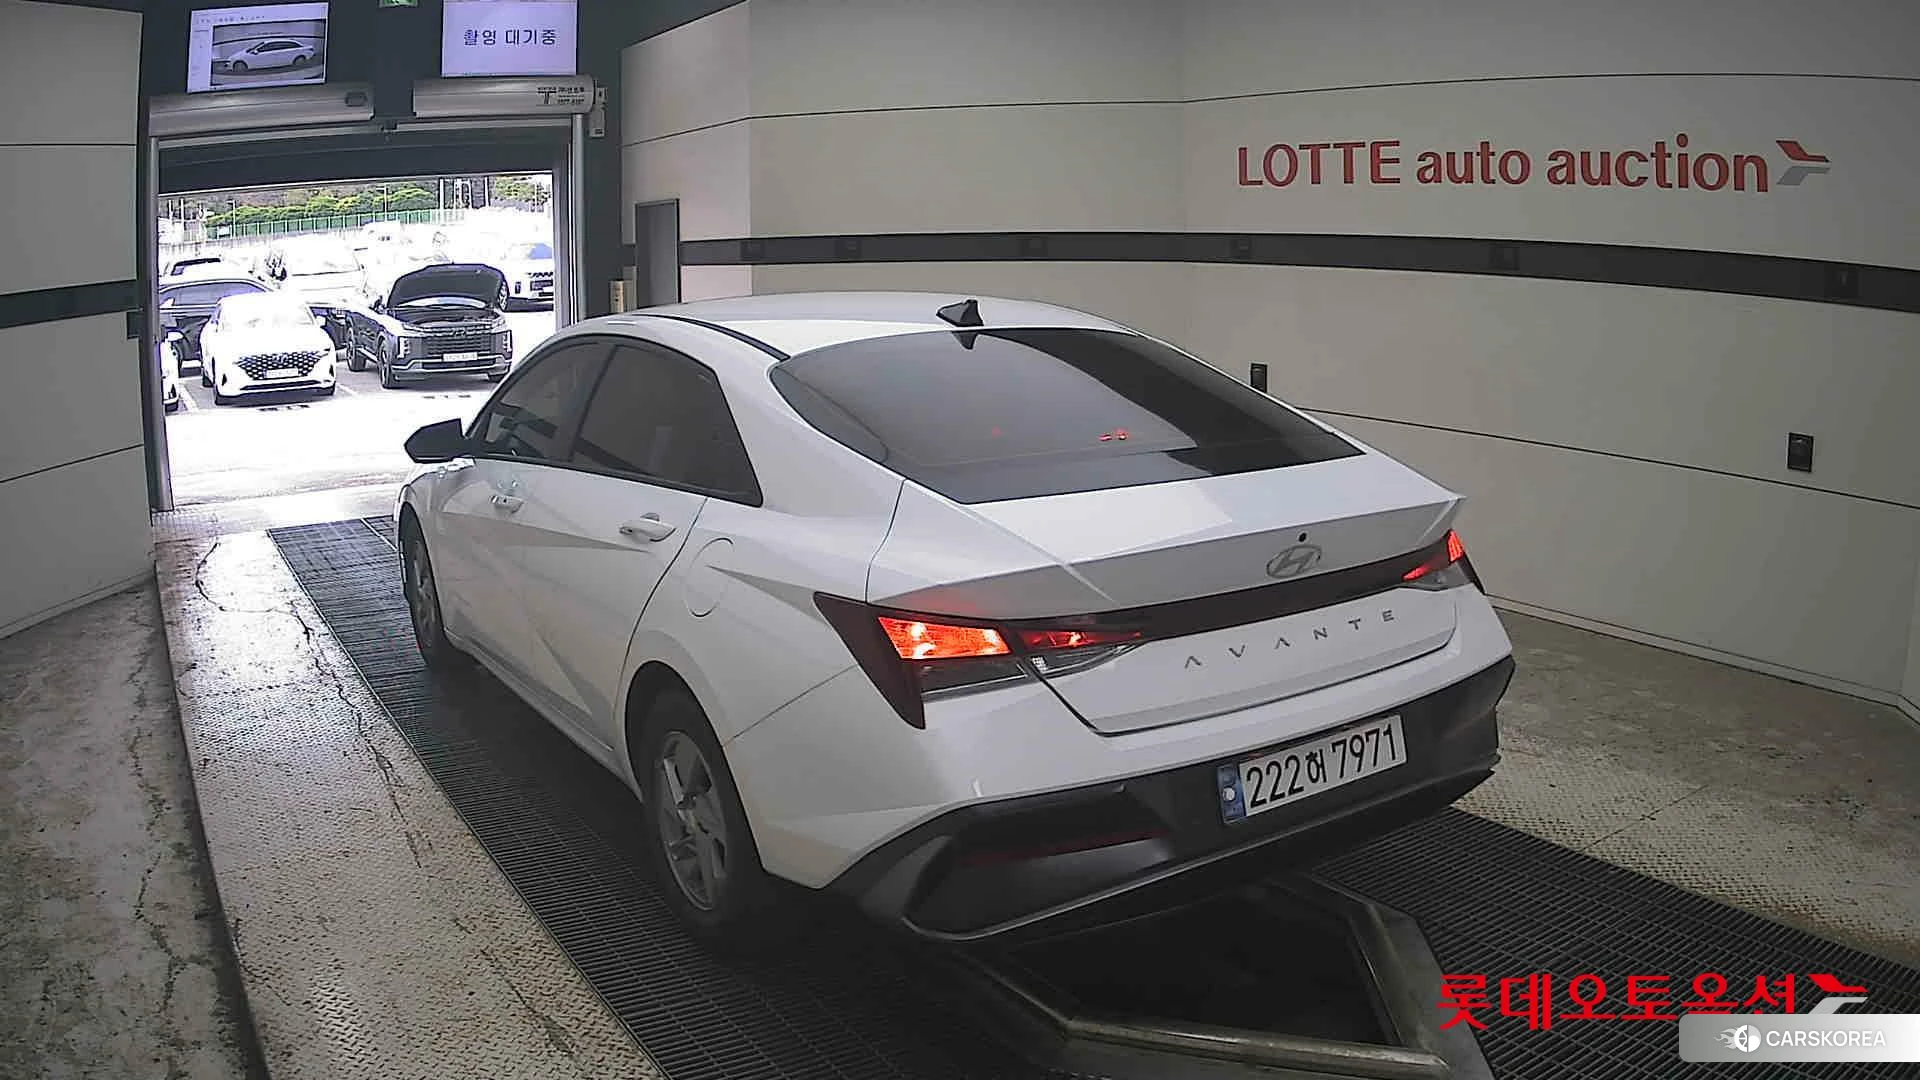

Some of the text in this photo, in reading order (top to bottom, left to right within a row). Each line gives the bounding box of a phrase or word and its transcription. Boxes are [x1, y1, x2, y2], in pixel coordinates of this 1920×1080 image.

[505, 29, 556, 46] 대기중
[1238, 133, 1768, 192] LOTTE auto auction
[1184, 609, 1395, 669] AVANTE
